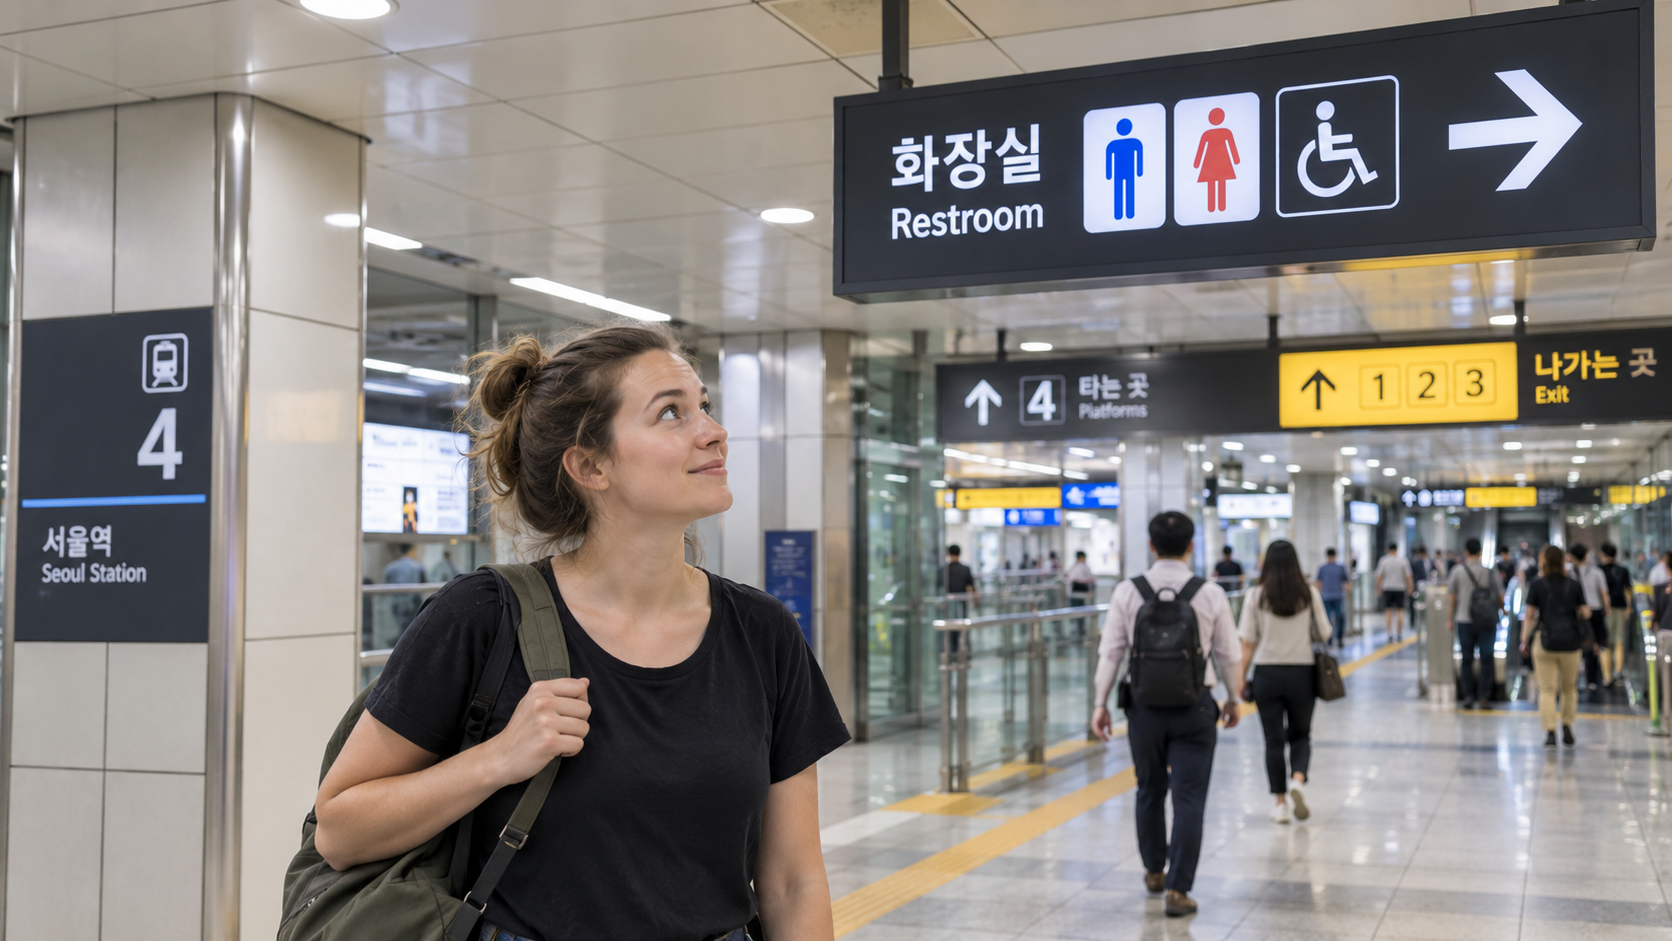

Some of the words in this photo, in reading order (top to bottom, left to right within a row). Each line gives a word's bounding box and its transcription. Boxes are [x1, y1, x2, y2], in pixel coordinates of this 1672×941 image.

[891, 123, 1041, 193] 화장실
[891, 203, 1044, 240] Restroom
[1534, 349, 1620, 382] 나가는
[1629, 347, 1657, 378] 곳
[1027, 380, 1057, 422] 4
[1078, 374, 1123, 400] 타는
[1126, 372, 1150, 399] 곳
[1373, 373, 1384, 400] 1
[1418, 371, 1436, 399] 2
[1465, 369, 1484, 397] 3
[1535, 384, 1570, 405] Exit
[1078, 401, 1149, 420] Platforms
[136, 407, 184, 481] 4
[42, 524, 112, 559] 서울역
[41, 562, 86, 584] Seoul
[89, 561, 147, 584] Station
